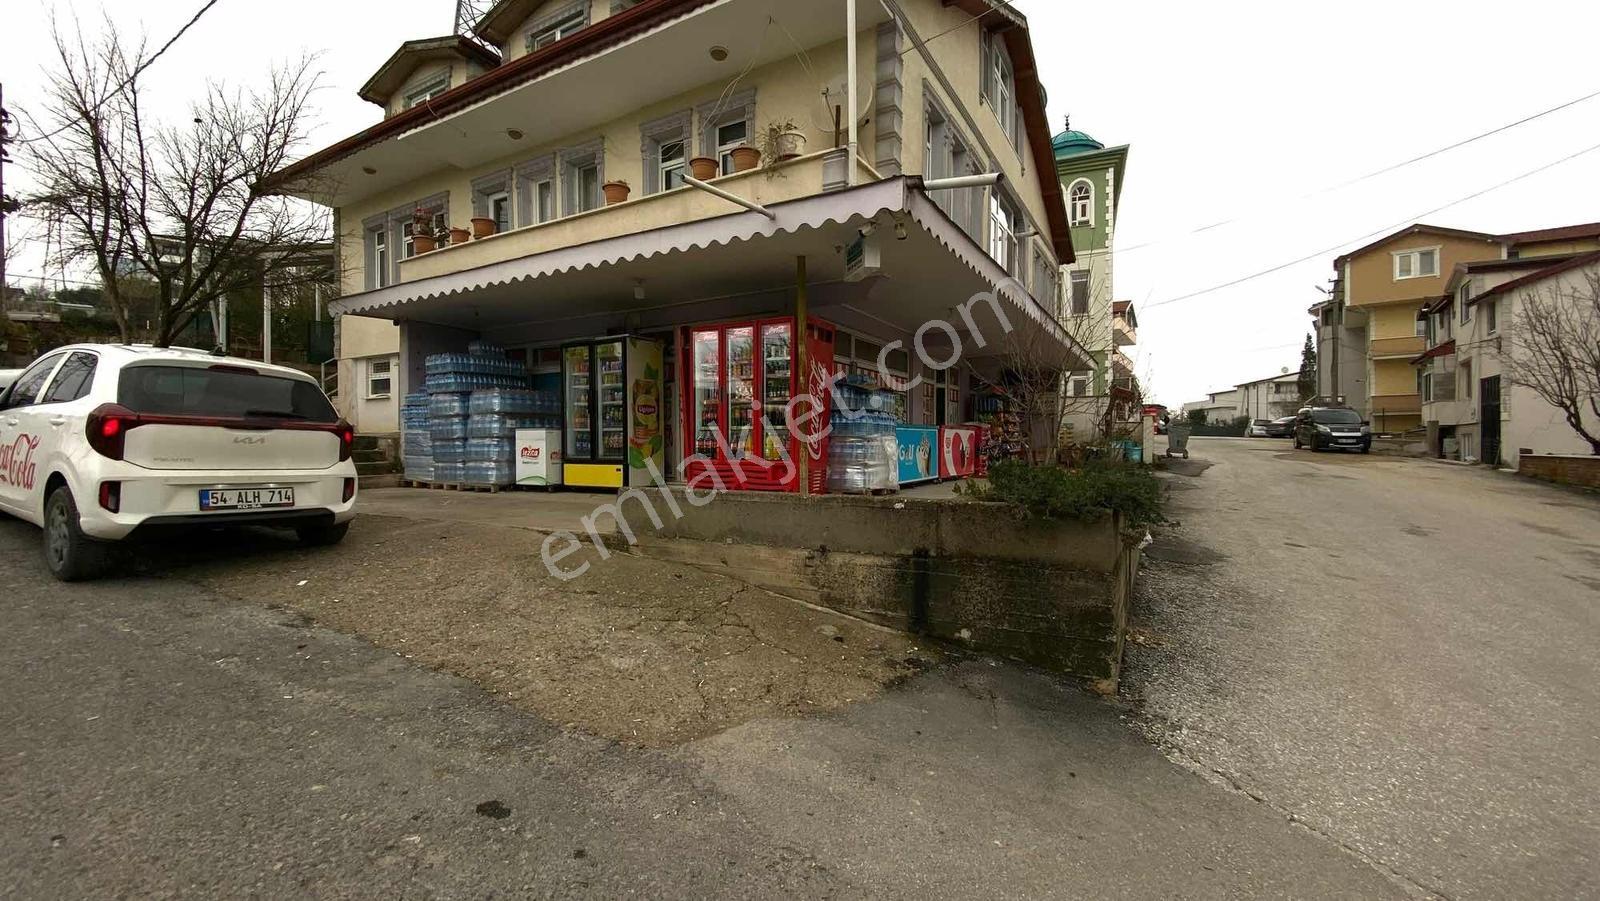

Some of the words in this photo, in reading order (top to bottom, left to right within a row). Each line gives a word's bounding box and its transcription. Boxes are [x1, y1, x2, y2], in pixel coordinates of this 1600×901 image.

[210, 492, 227, 504] 54
[237, 491, 260, 503] ALH
[268, 490, 291, 502] 714
